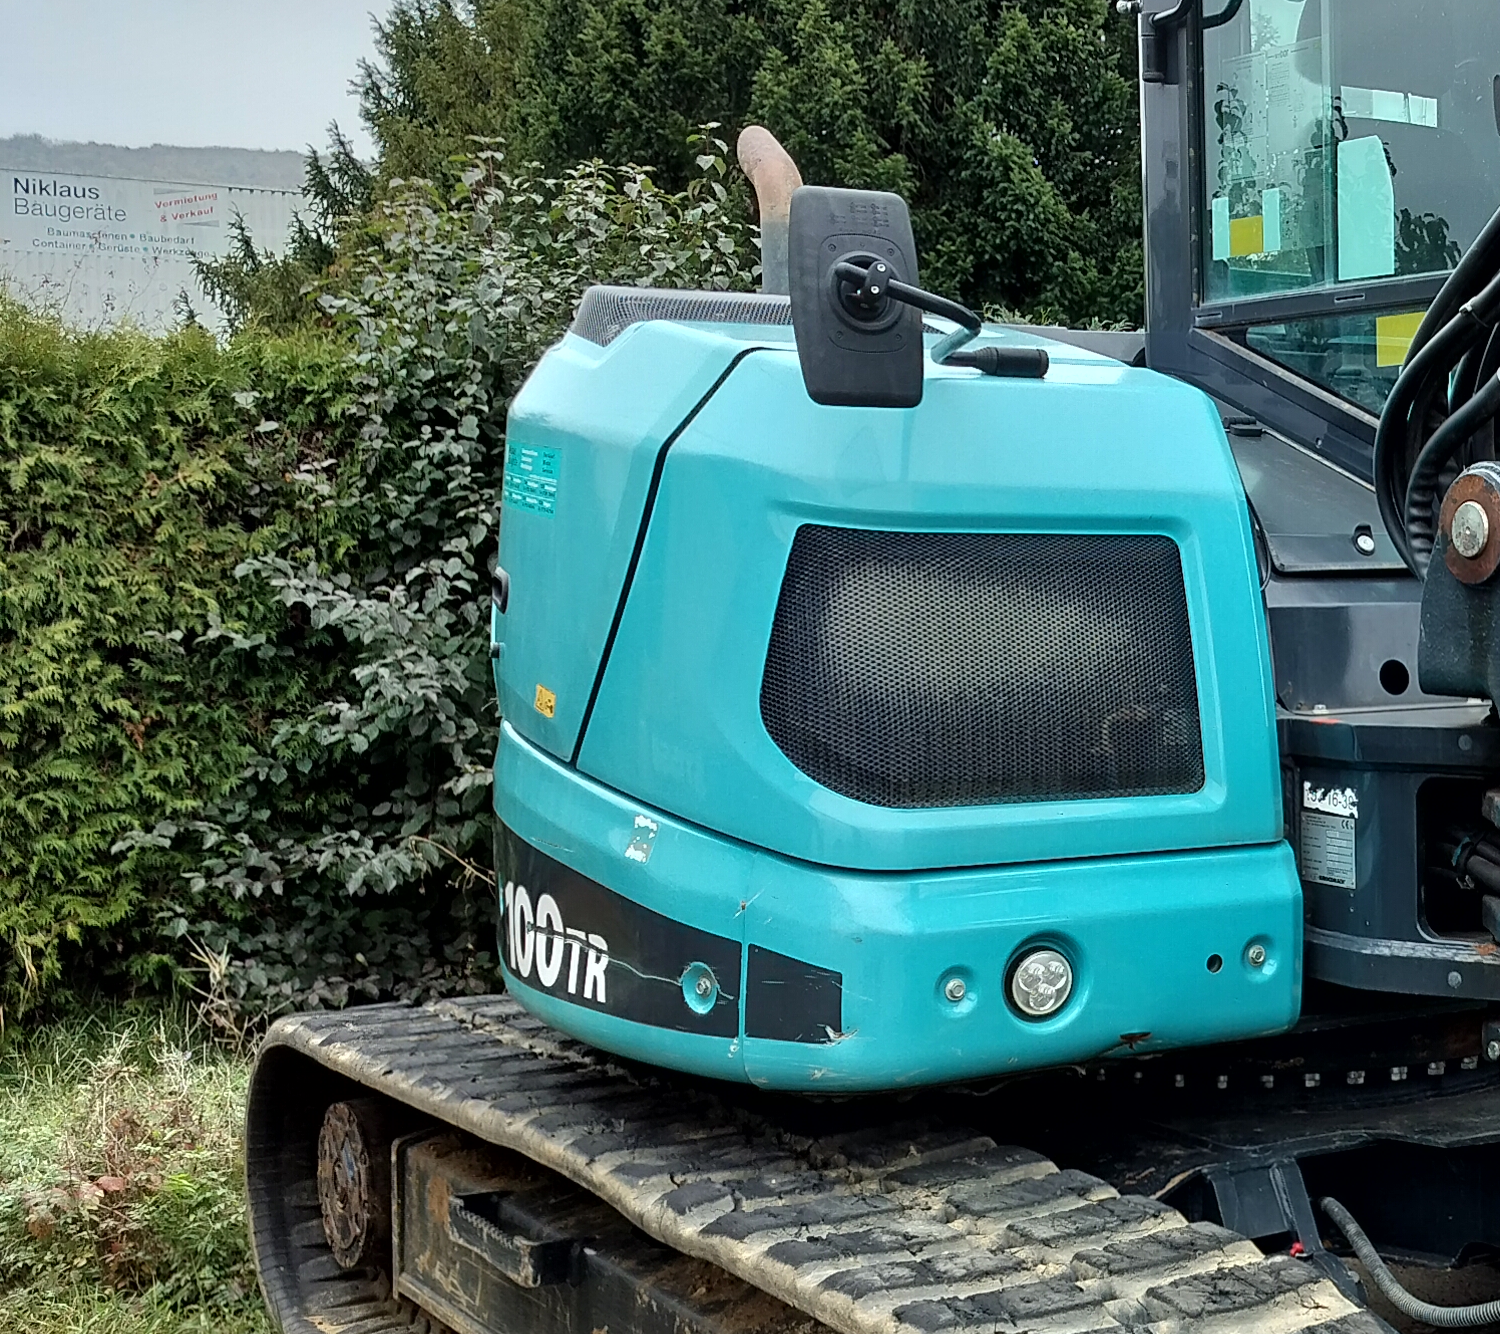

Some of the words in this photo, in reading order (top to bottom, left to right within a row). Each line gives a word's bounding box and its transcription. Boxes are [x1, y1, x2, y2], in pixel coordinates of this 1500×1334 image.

[13, 177, 100, 201] Niklaus
[13, 197, 127, 223] Baugeräte
[154, 191, 219, 210] Vermietung
[171, 205, 215, 222] Verkauf
[32, 238, 87, 251] Container
[151, 246, 211, 259] Werkzege
[505, 880, 609, 1004] 100TR
